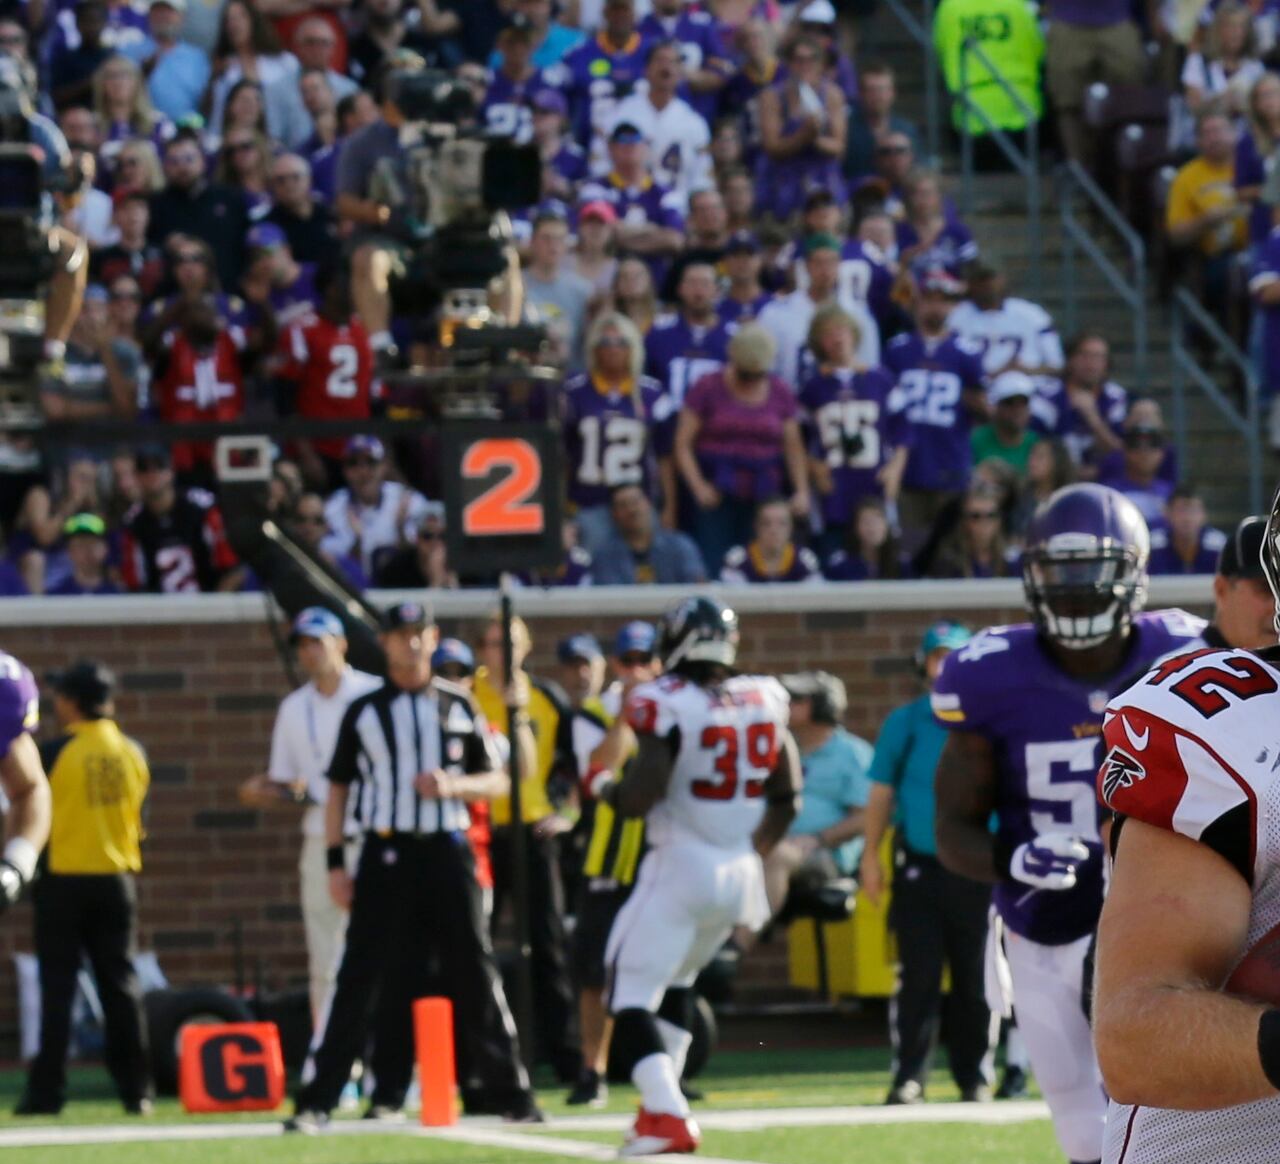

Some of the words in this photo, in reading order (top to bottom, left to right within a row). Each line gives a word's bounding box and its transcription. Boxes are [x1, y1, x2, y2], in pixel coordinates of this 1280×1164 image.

[327, 344, 357, 398] 2
[900, 369, 961, 428] 22
[578, 416, 644, 485] 12
[462, 438, 545, 536] 2
[692, 722, 779, 800] 39
[202, 1033, 269, 1100] G
